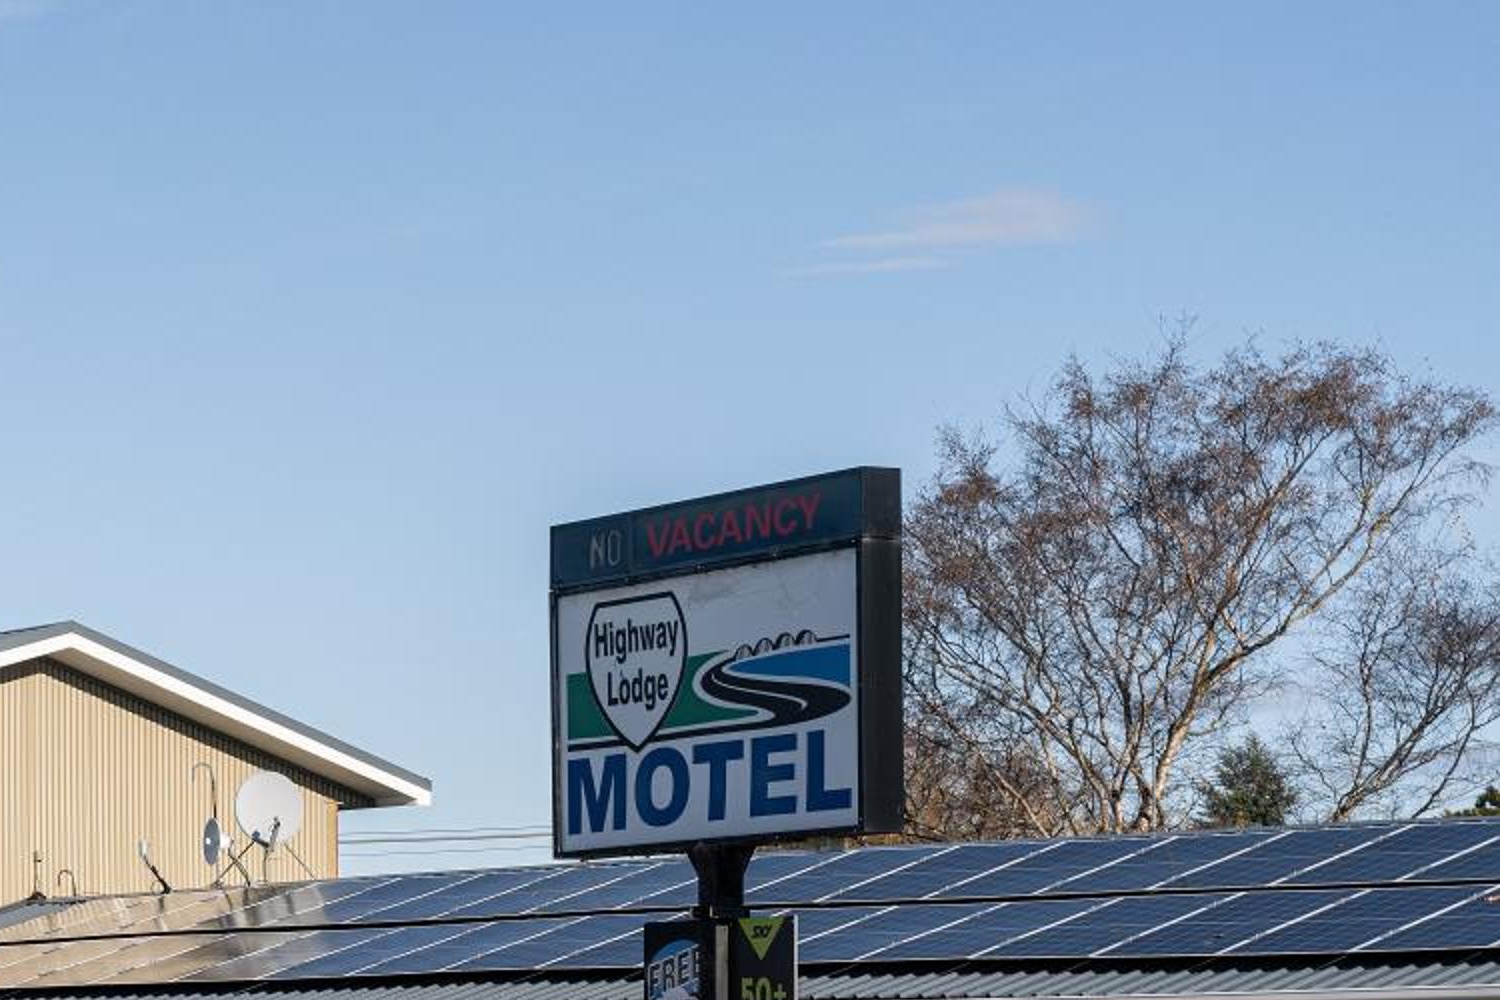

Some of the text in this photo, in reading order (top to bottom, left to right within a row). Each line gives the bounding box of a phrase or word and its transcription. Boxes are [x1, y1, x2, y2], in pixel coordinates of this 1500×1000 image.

[589, 494, 821, 570] NO VACANCY
[593, 618, 679, 664] Highway
[606, 668, 669, 711] Lodge
[567, 729, 853, 835] MOTEL
